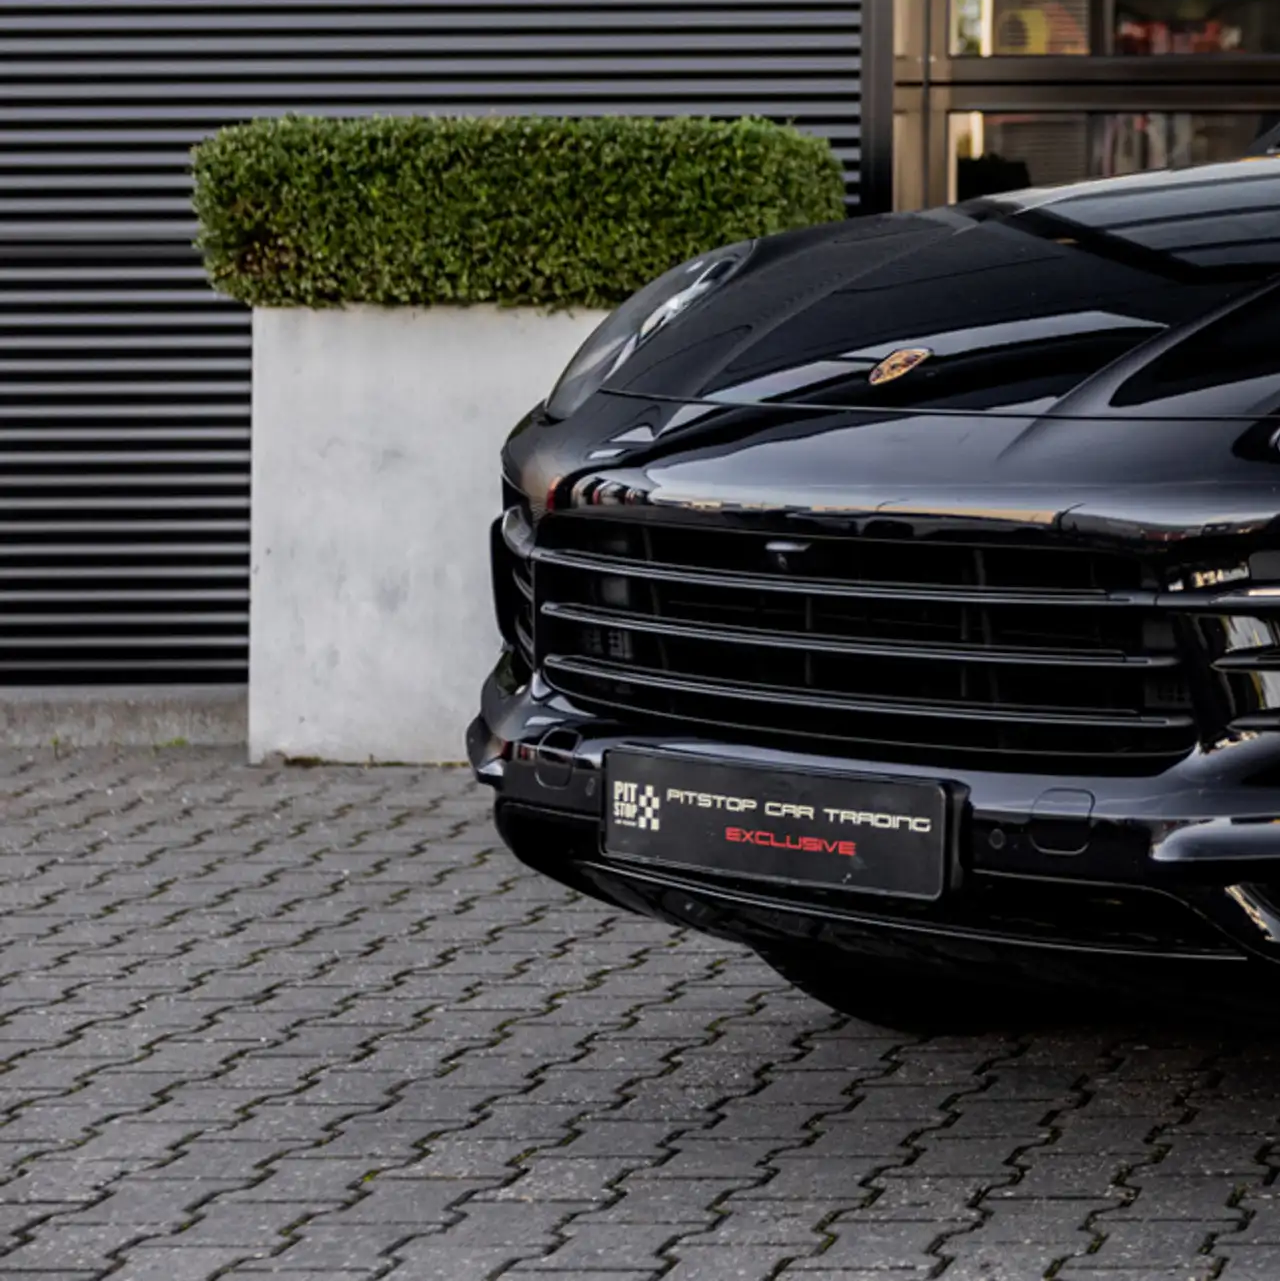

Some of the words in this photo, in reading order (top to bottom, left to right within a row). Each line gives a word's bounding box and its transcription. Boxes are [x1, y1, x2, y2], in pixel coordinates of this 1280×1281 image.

[613, 780, 638, 802] PIT
[613, 801, 637, 819] STOP
[666, 788, 758, 812] PITSTOP
[764, 801, 815, 820] CAR
[823, 808, 932, 833] TRADING
[725, 827, 857, 856] EXCLUSIVE
